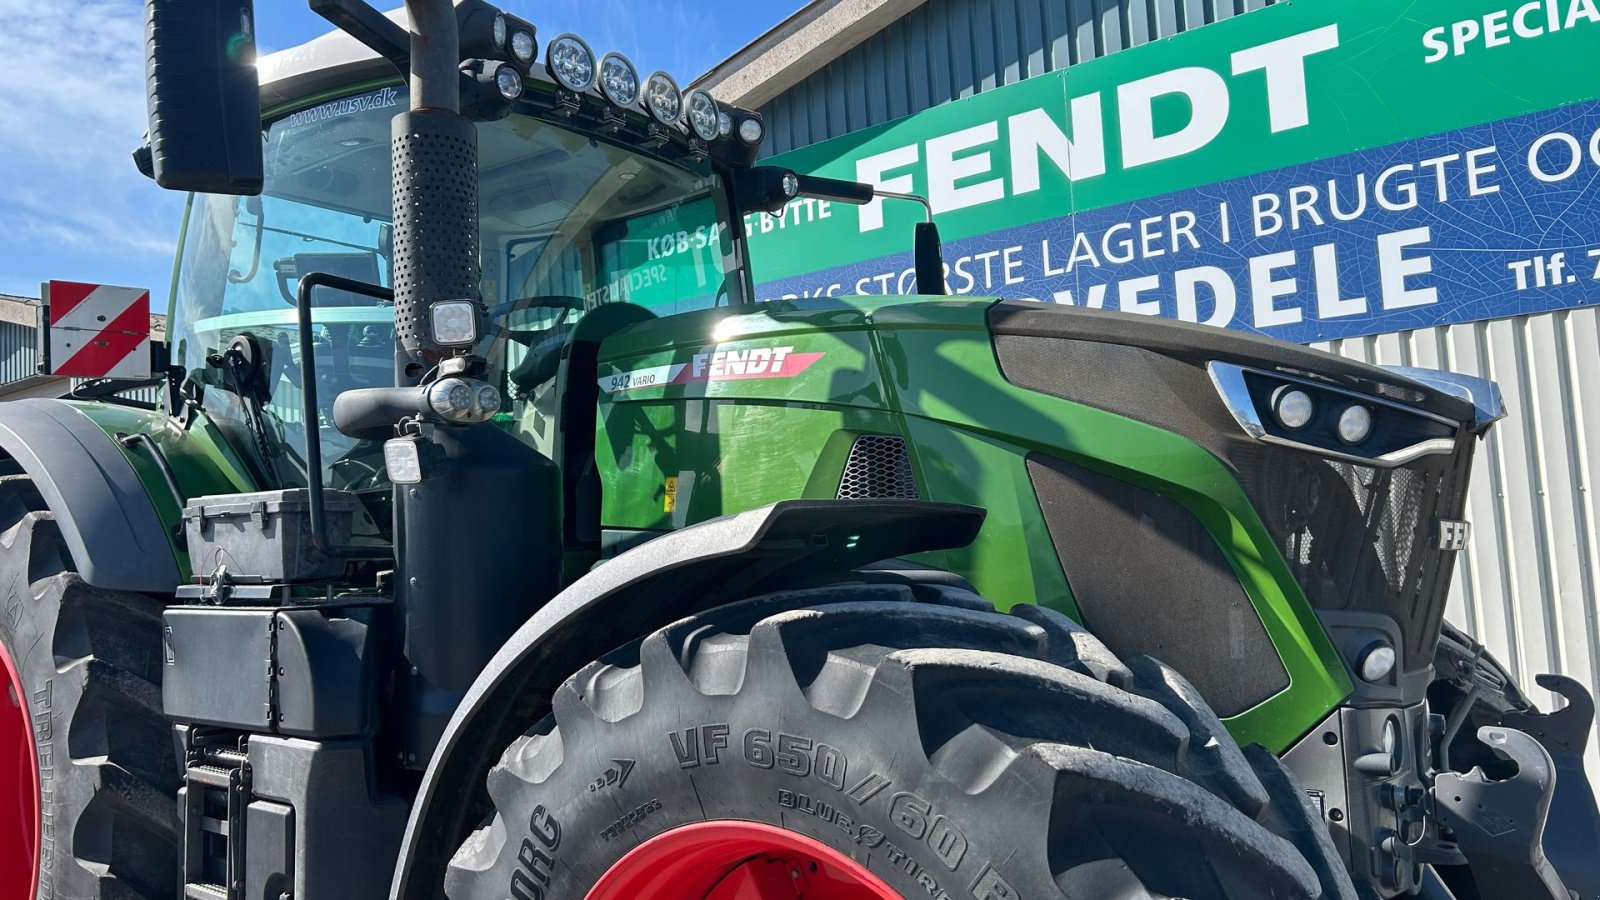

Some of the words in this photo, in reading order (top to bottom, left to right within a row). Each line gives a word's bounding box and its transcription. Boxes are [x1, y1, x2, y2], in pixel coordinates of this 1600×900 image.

[290, 87, 397, 127] www.usv.dk
[855, 23, 1339, 233] FENDT
[1042, 210, 1200, 277] LAGER
[1219, 202, 1230, 243] I
[1252, 146, 1500, 238] BRUGTE
[1527, 127, 1600, 182] O
[1508, 252, 1576, 290] Tlf.
[611, 374, 631, 391] 942
[632, 374, 656, 387] VARIO
[692, 346, 794, 378] FENDT
[668, 723, 730, 770] VF
[743, 727, 968, 872] 650/60
[778, 788, 855, 835] BLUE
